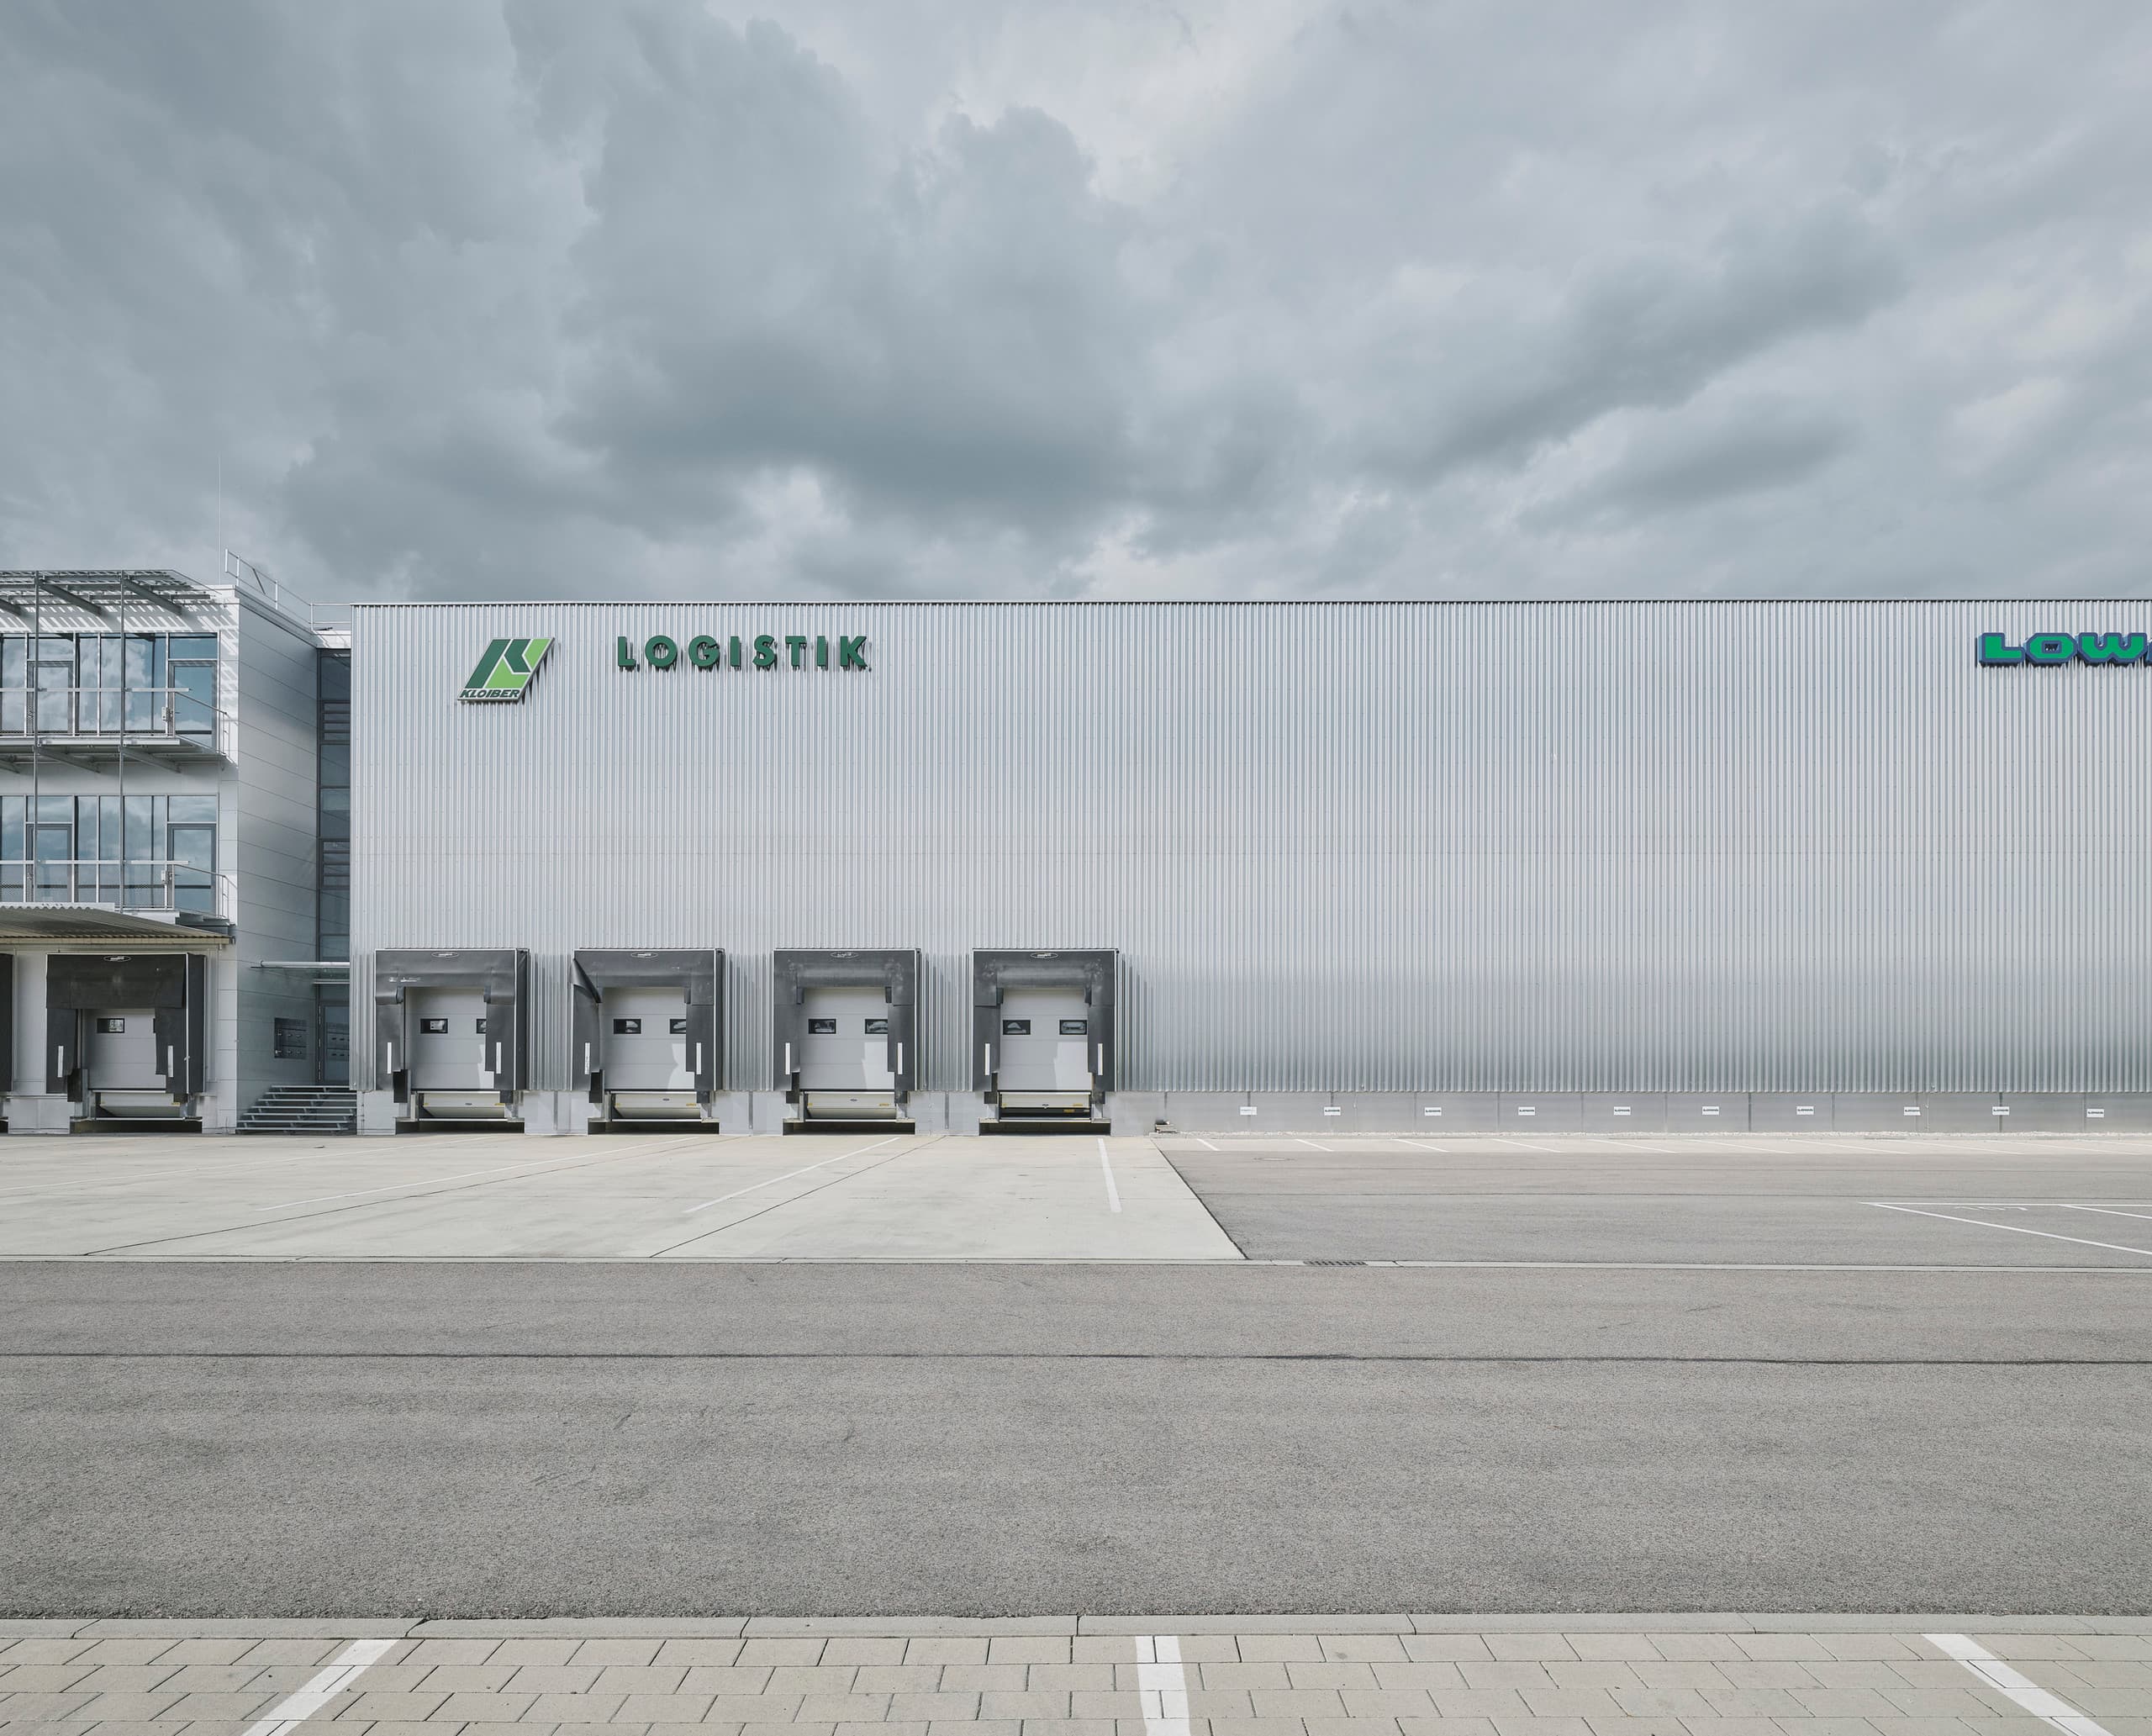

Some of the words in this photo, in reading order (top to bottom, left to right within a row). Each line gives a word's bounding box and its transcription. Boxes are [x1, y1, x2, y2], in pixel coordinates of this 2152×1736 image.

[617, 635, 868, 667] LOGISTIK
[1979, 632, 2152, 662] LOW
[459, 689, 520, 698] KLOIBER
